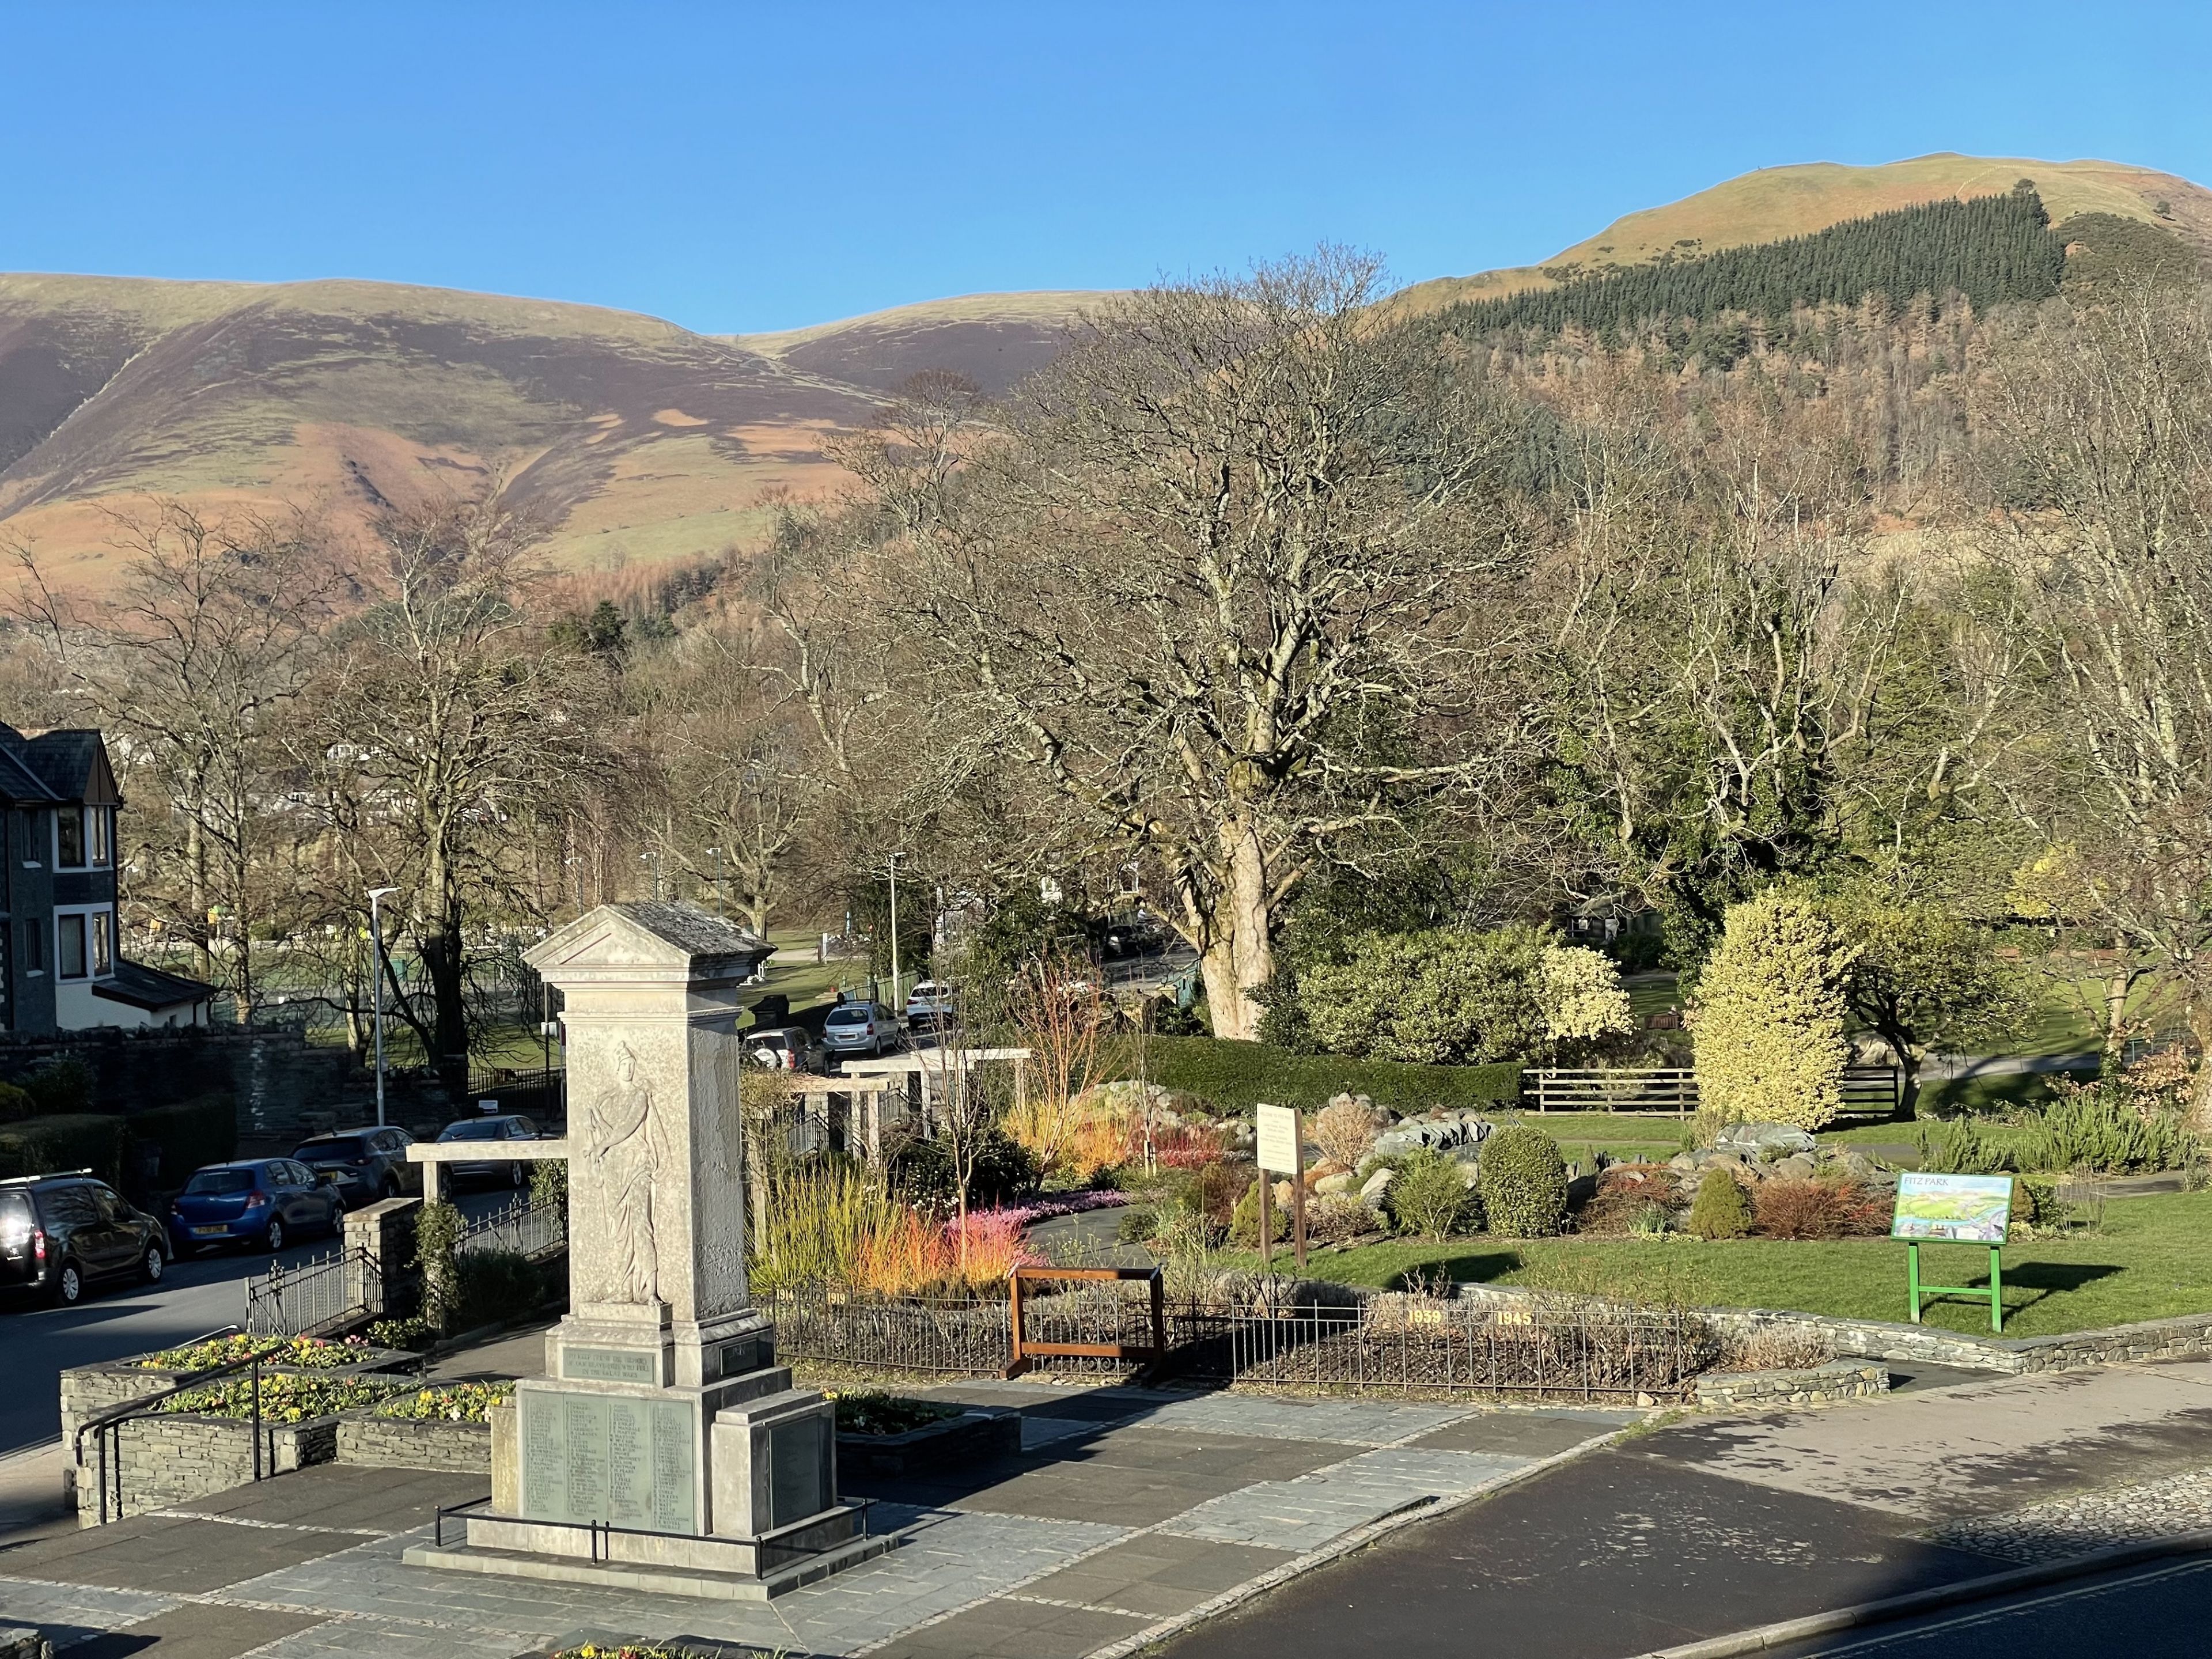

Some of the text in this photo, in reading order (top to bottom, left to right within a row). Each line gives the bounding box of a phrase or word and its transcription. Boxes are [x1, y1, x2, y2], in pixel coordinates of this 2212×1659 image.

[1904, 1177, 1923, 1185] FITZ
[1925, 1178, 1949, 1186] PARK
[776, 1289, 794, 1301] 1914
[828, 1292, 846, 1305] 1919
[1408, 1309, 1442, 1324] 1939
[1498, 1311, 1532, 1325] 1945
